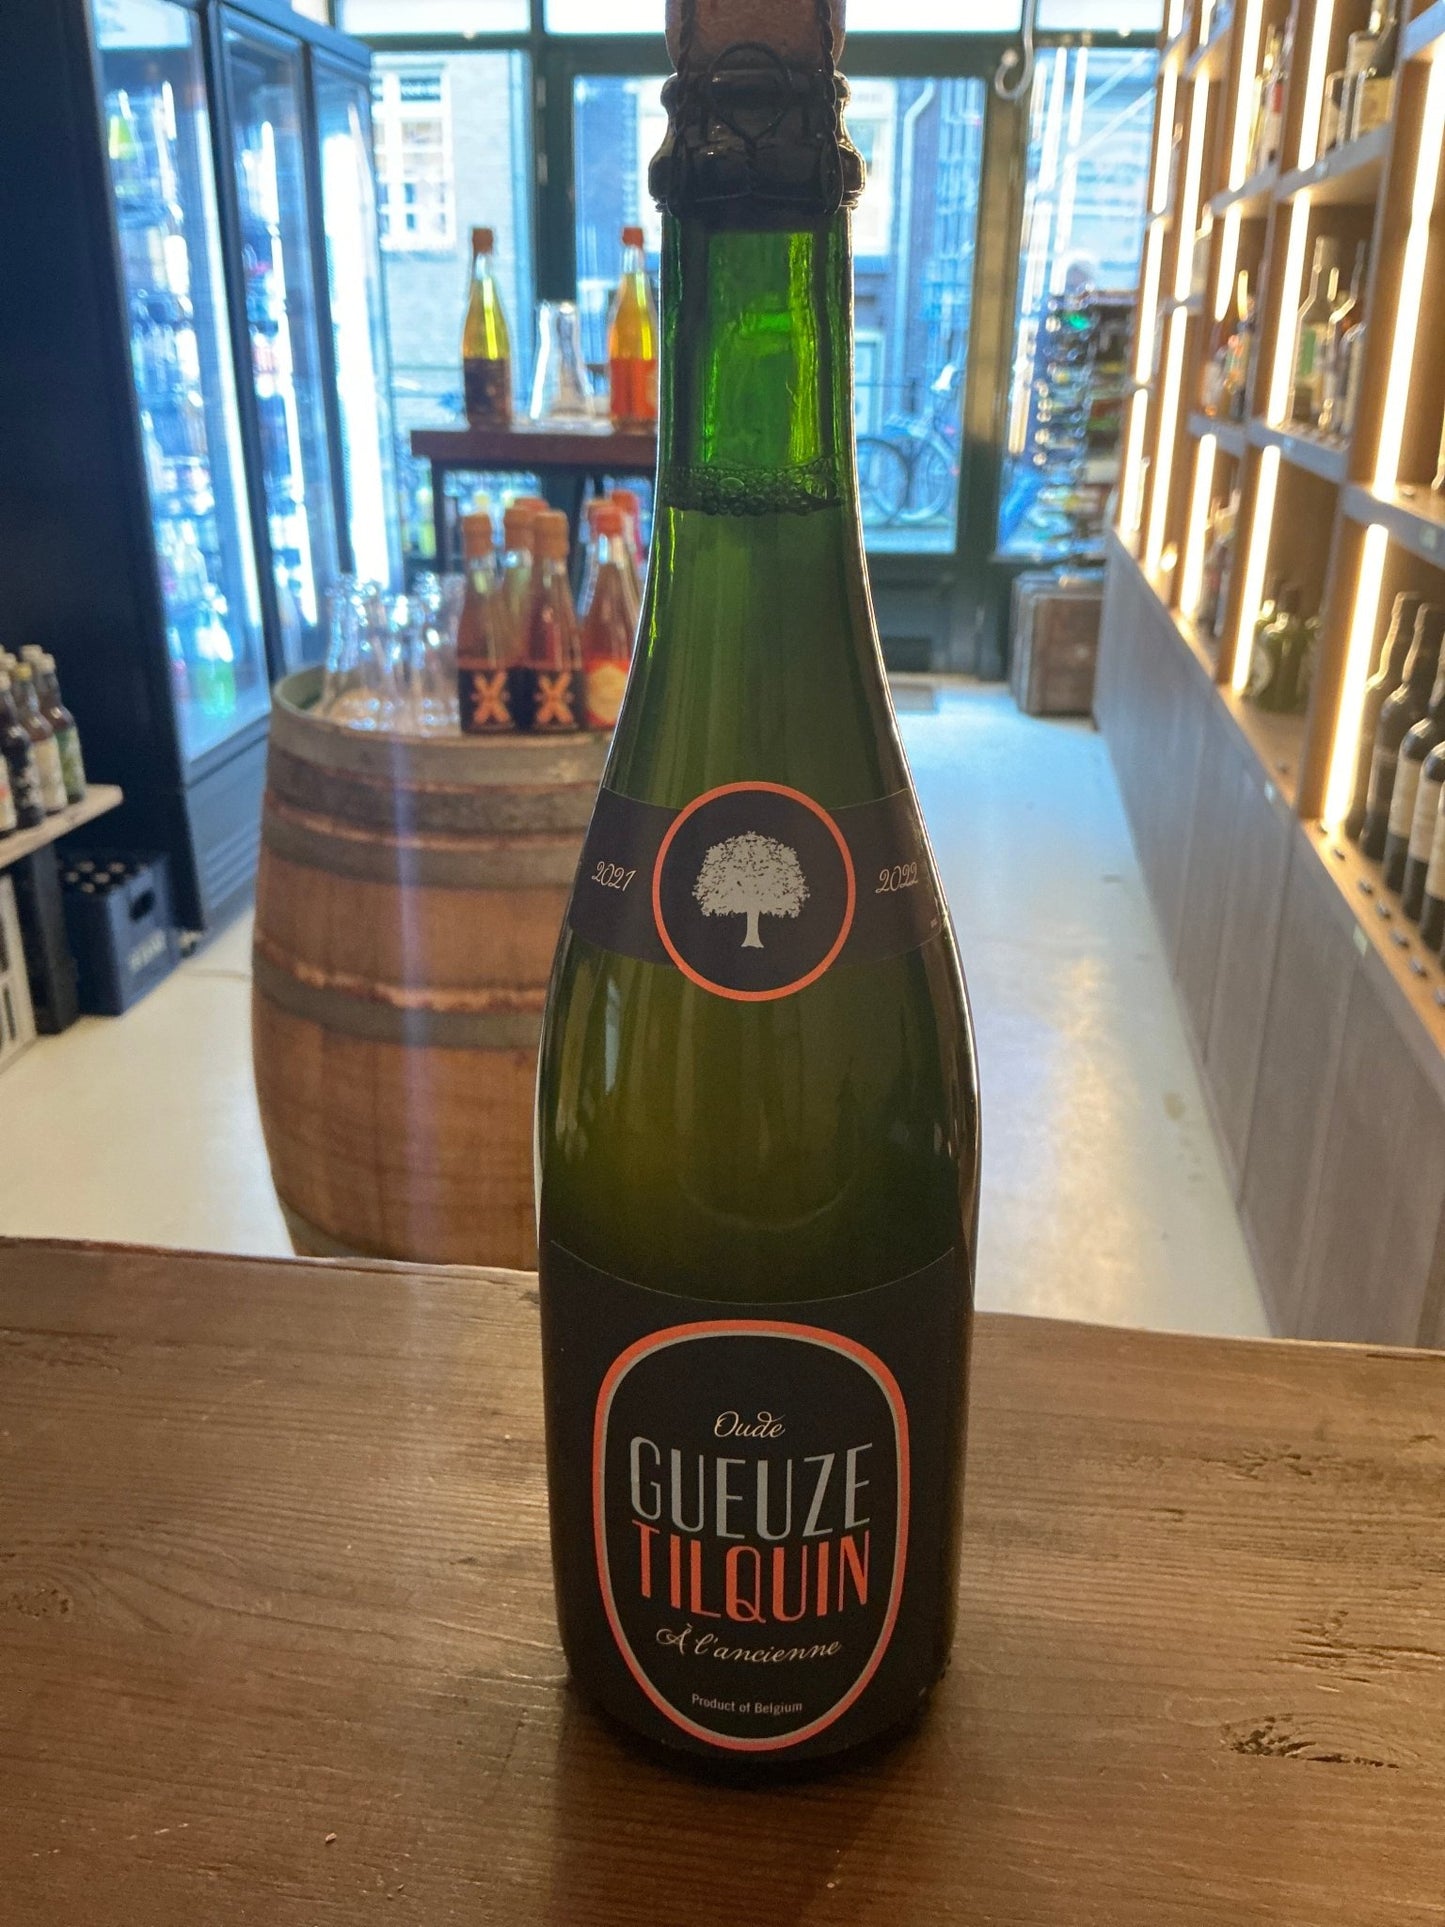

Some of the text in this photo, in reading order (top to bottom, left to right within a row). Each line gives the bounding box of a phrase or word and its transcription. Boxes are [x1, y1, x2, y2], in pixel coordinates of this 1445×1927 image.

[591, 861, 636, 892] 2021
[875, 862, 919, 894] 2022
[713, 1410, 787, 1439] Oude
[630, 1436, 873, 1541] GUEUZE
[631, 1518, 870, 1624] TILQUIN
[656, 1622, 843, 1664] À l'ancienne
[691, 1693, 803, 1716] Product of Belgium
